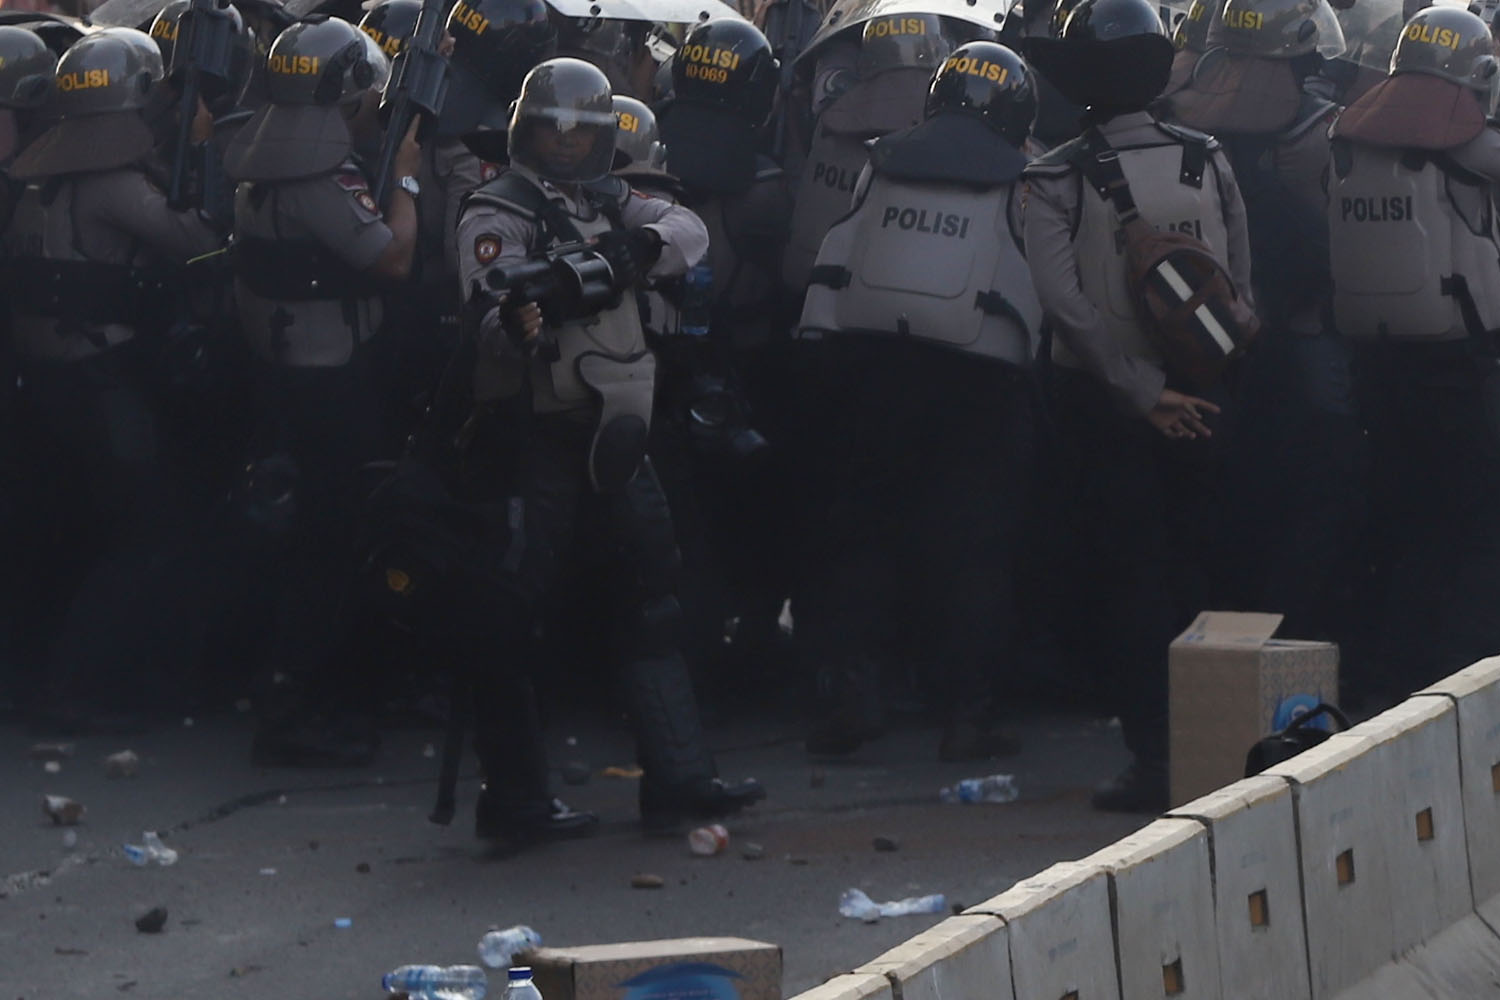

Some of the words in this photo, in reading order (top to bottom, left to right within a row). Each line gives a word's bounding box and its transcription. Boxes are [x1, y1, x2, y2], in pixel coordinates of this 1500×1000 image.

[866, 18, 926, 39] POLISI
[682, 44, 740, 71] POLISI
[945, 56, 1008, 85] POLISI
[1341, 195, 1412, 222] POLISI
[881, 206, 970, 239] POLISI
